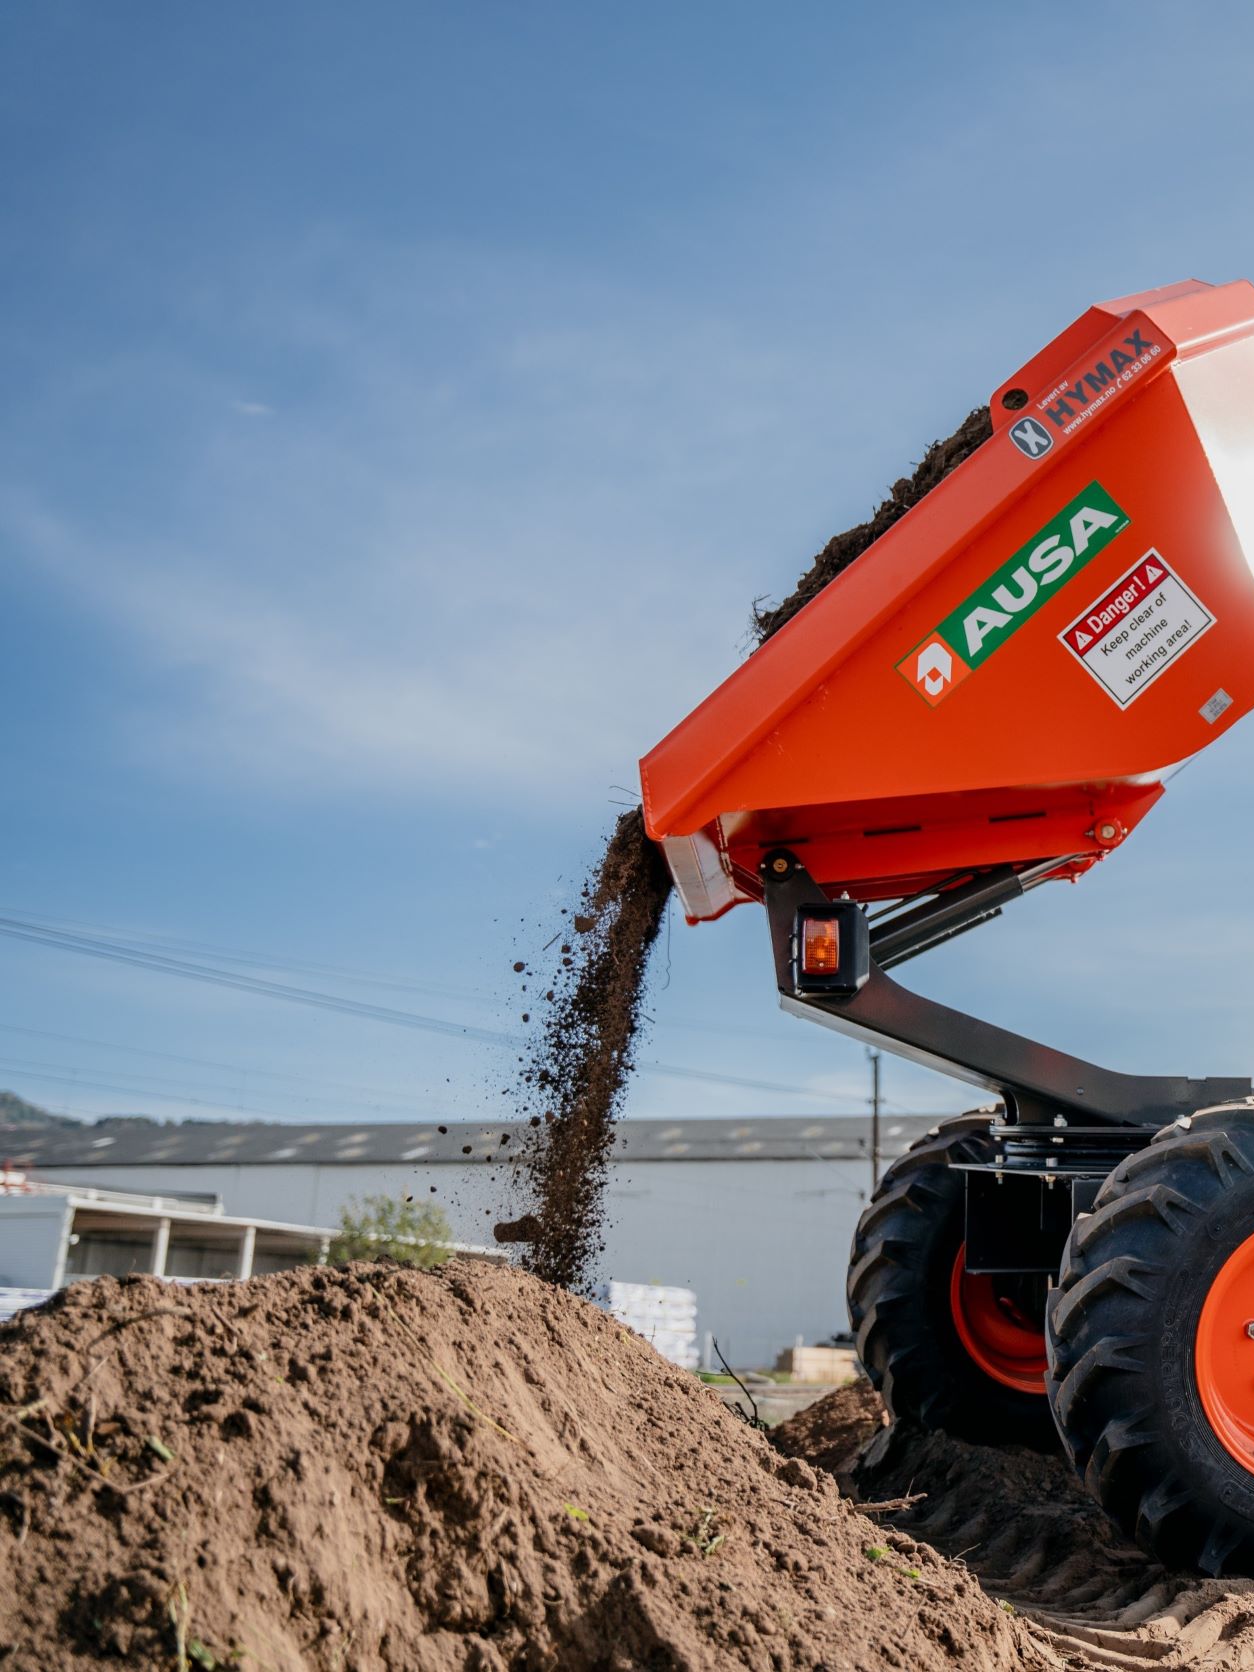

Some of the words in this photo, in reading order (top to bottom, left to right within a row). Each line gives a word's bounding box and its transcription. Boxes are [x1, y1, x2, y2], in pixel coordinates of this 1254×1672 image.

[1036, 388, 1061, 410] Levert
[1059, 380, 1069, 391] av
[1045, 328, 1152, 427] HYMAX
[1063, 386, 1116, 434] www.hymax.no
[962, 506, 1119, 657] AUSA
[1100, 629, 1129, 656] Keep
[1129, 605, 1154, 631] clear
[1155, 592, 1167, 607] of
[1125, 618, 1168, 660] machine
[1125, 645, 1168, 685] working
[1166, 619, 1192, 647] area!
